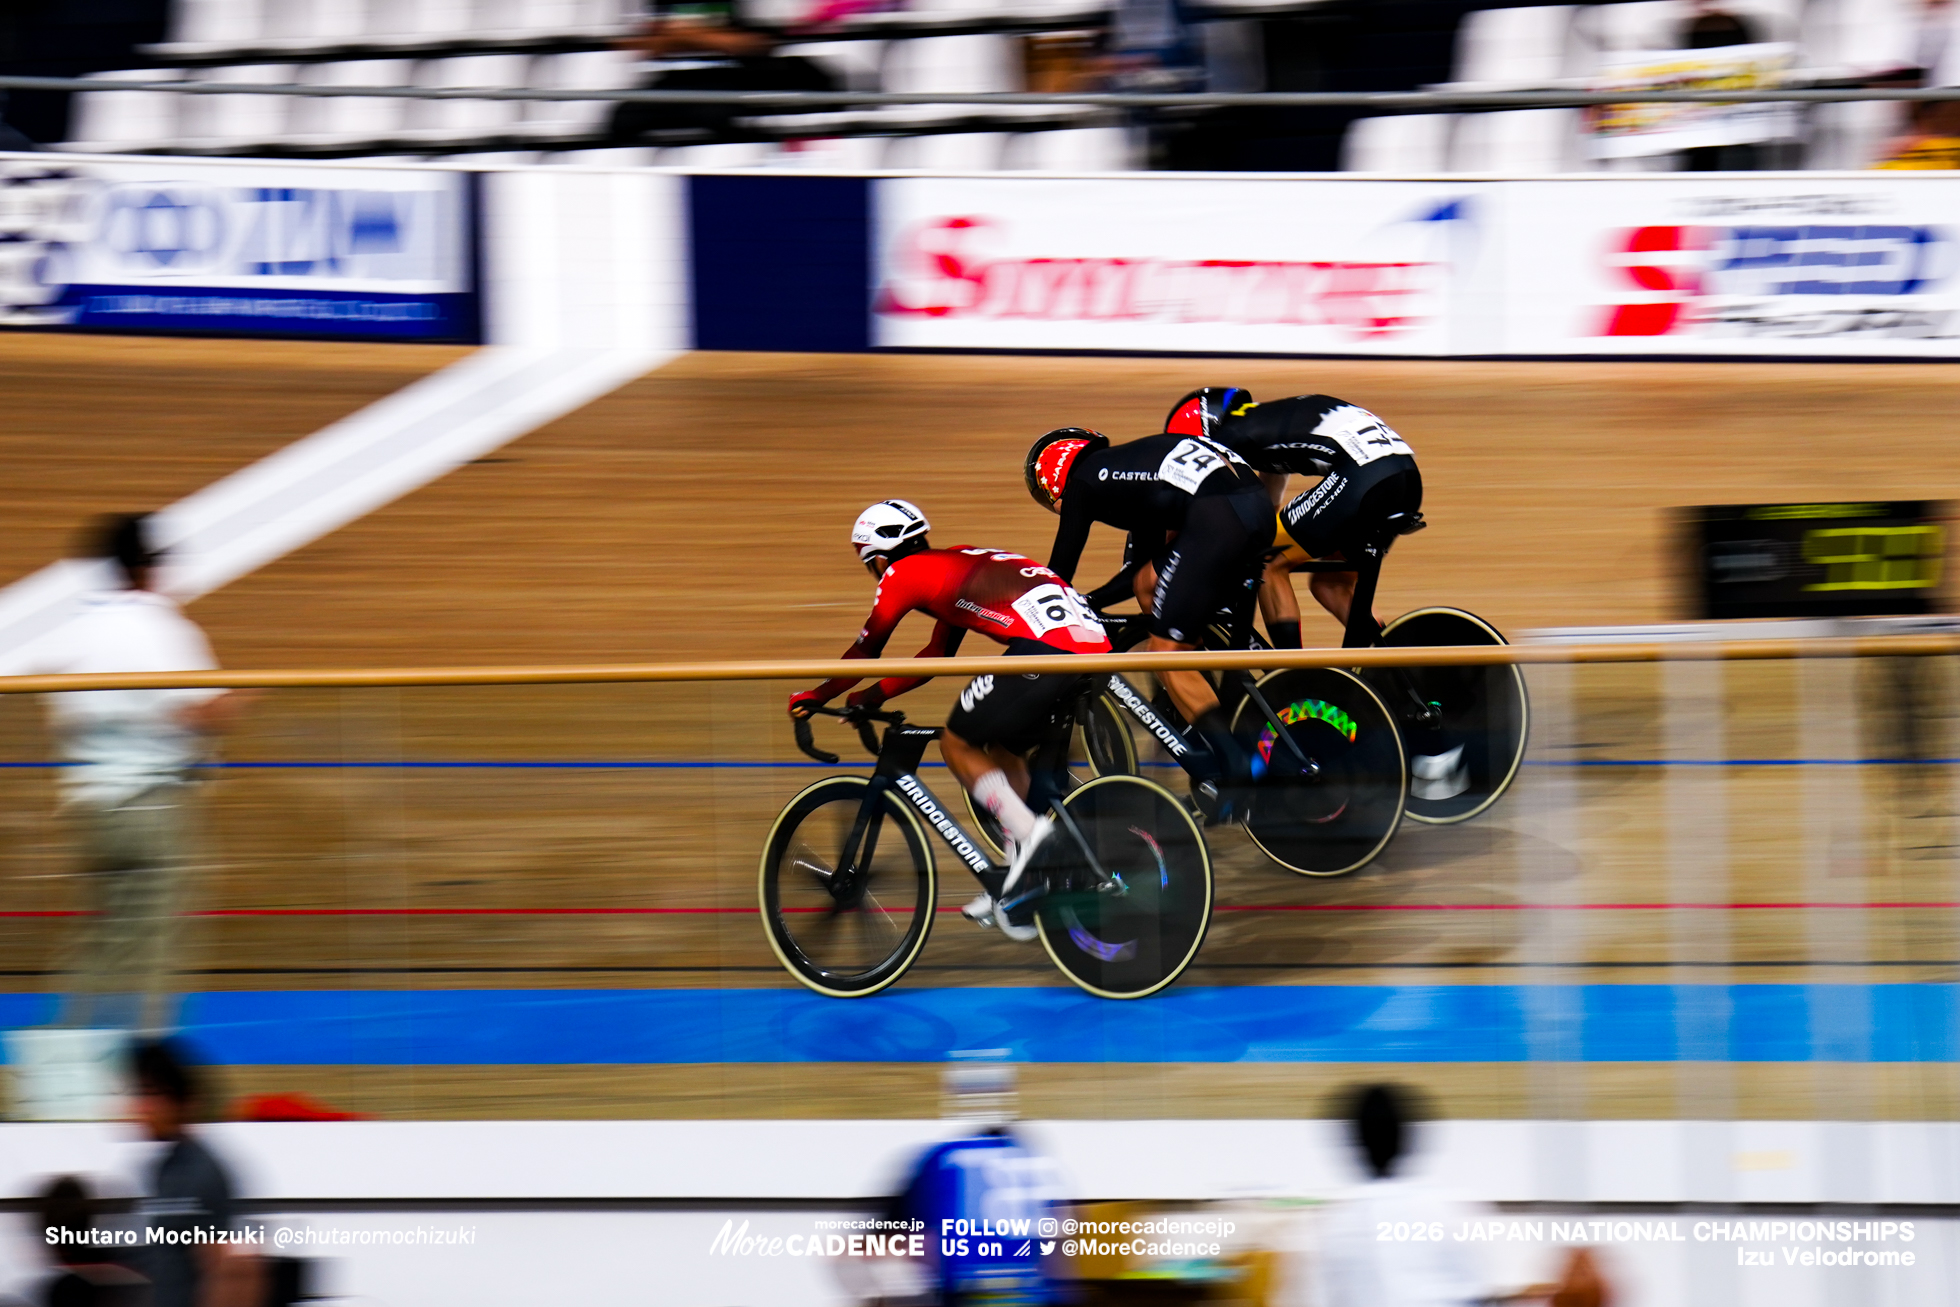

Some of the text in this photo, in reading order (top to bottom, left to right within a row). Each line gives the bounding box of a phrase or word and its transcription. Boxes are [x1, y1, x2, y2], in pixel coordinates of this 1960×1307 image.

[1052, 442, 1074, 482] JAPAN
[1112, 470, 1160, 481] CASTELL
[1172, 443, 1217, 472] 24
[1288, 471, 1340, 526] BRIDGESTONE
[1312, 477, 1348, 519] ANCHOR
[1037, 594, 1074, 622] 16
[1107, 674, 1188, 757] RIDGESTONE
[895, 774, 989, 873] BRIDGESTONE
